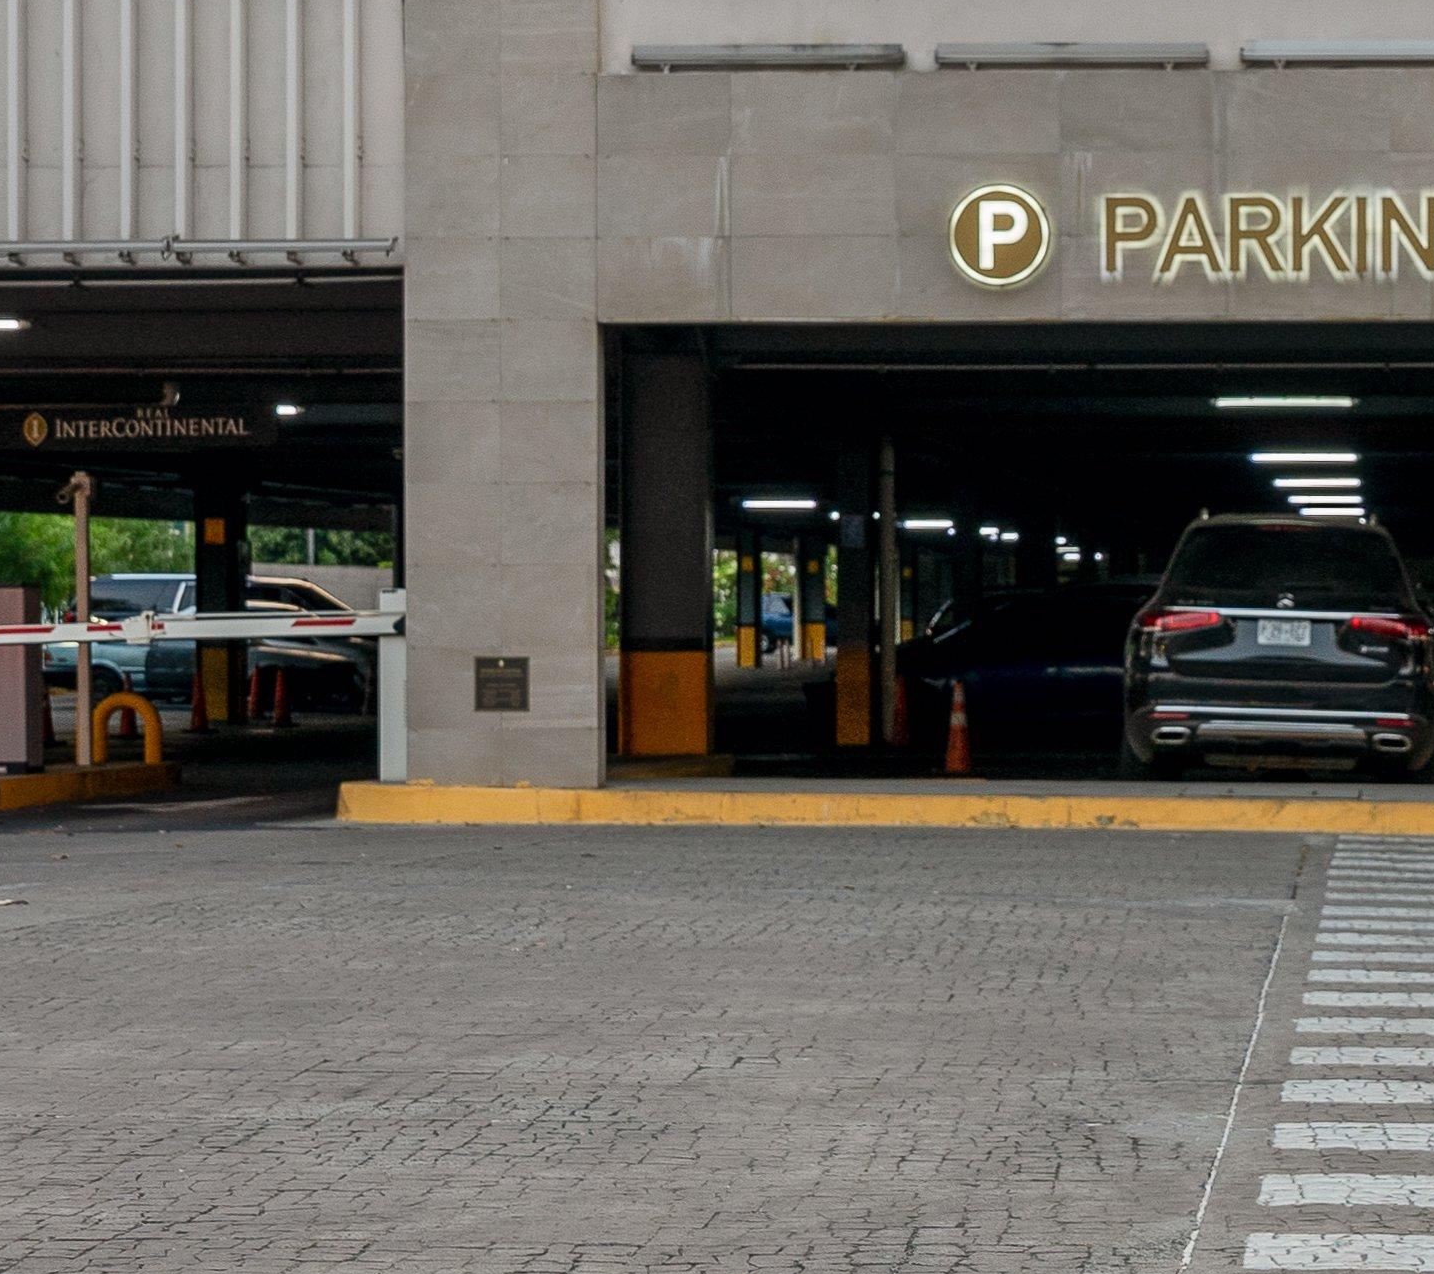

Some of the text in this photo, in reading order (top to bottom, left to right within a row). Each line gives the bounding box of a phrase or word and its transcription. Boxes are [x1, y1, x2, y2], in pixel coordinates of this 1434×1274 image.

[977, 199, 1029, 271] P
[137, 408, 169, 418] REAL
[55, 416, 250, 439] INTERCONTINENTAL
